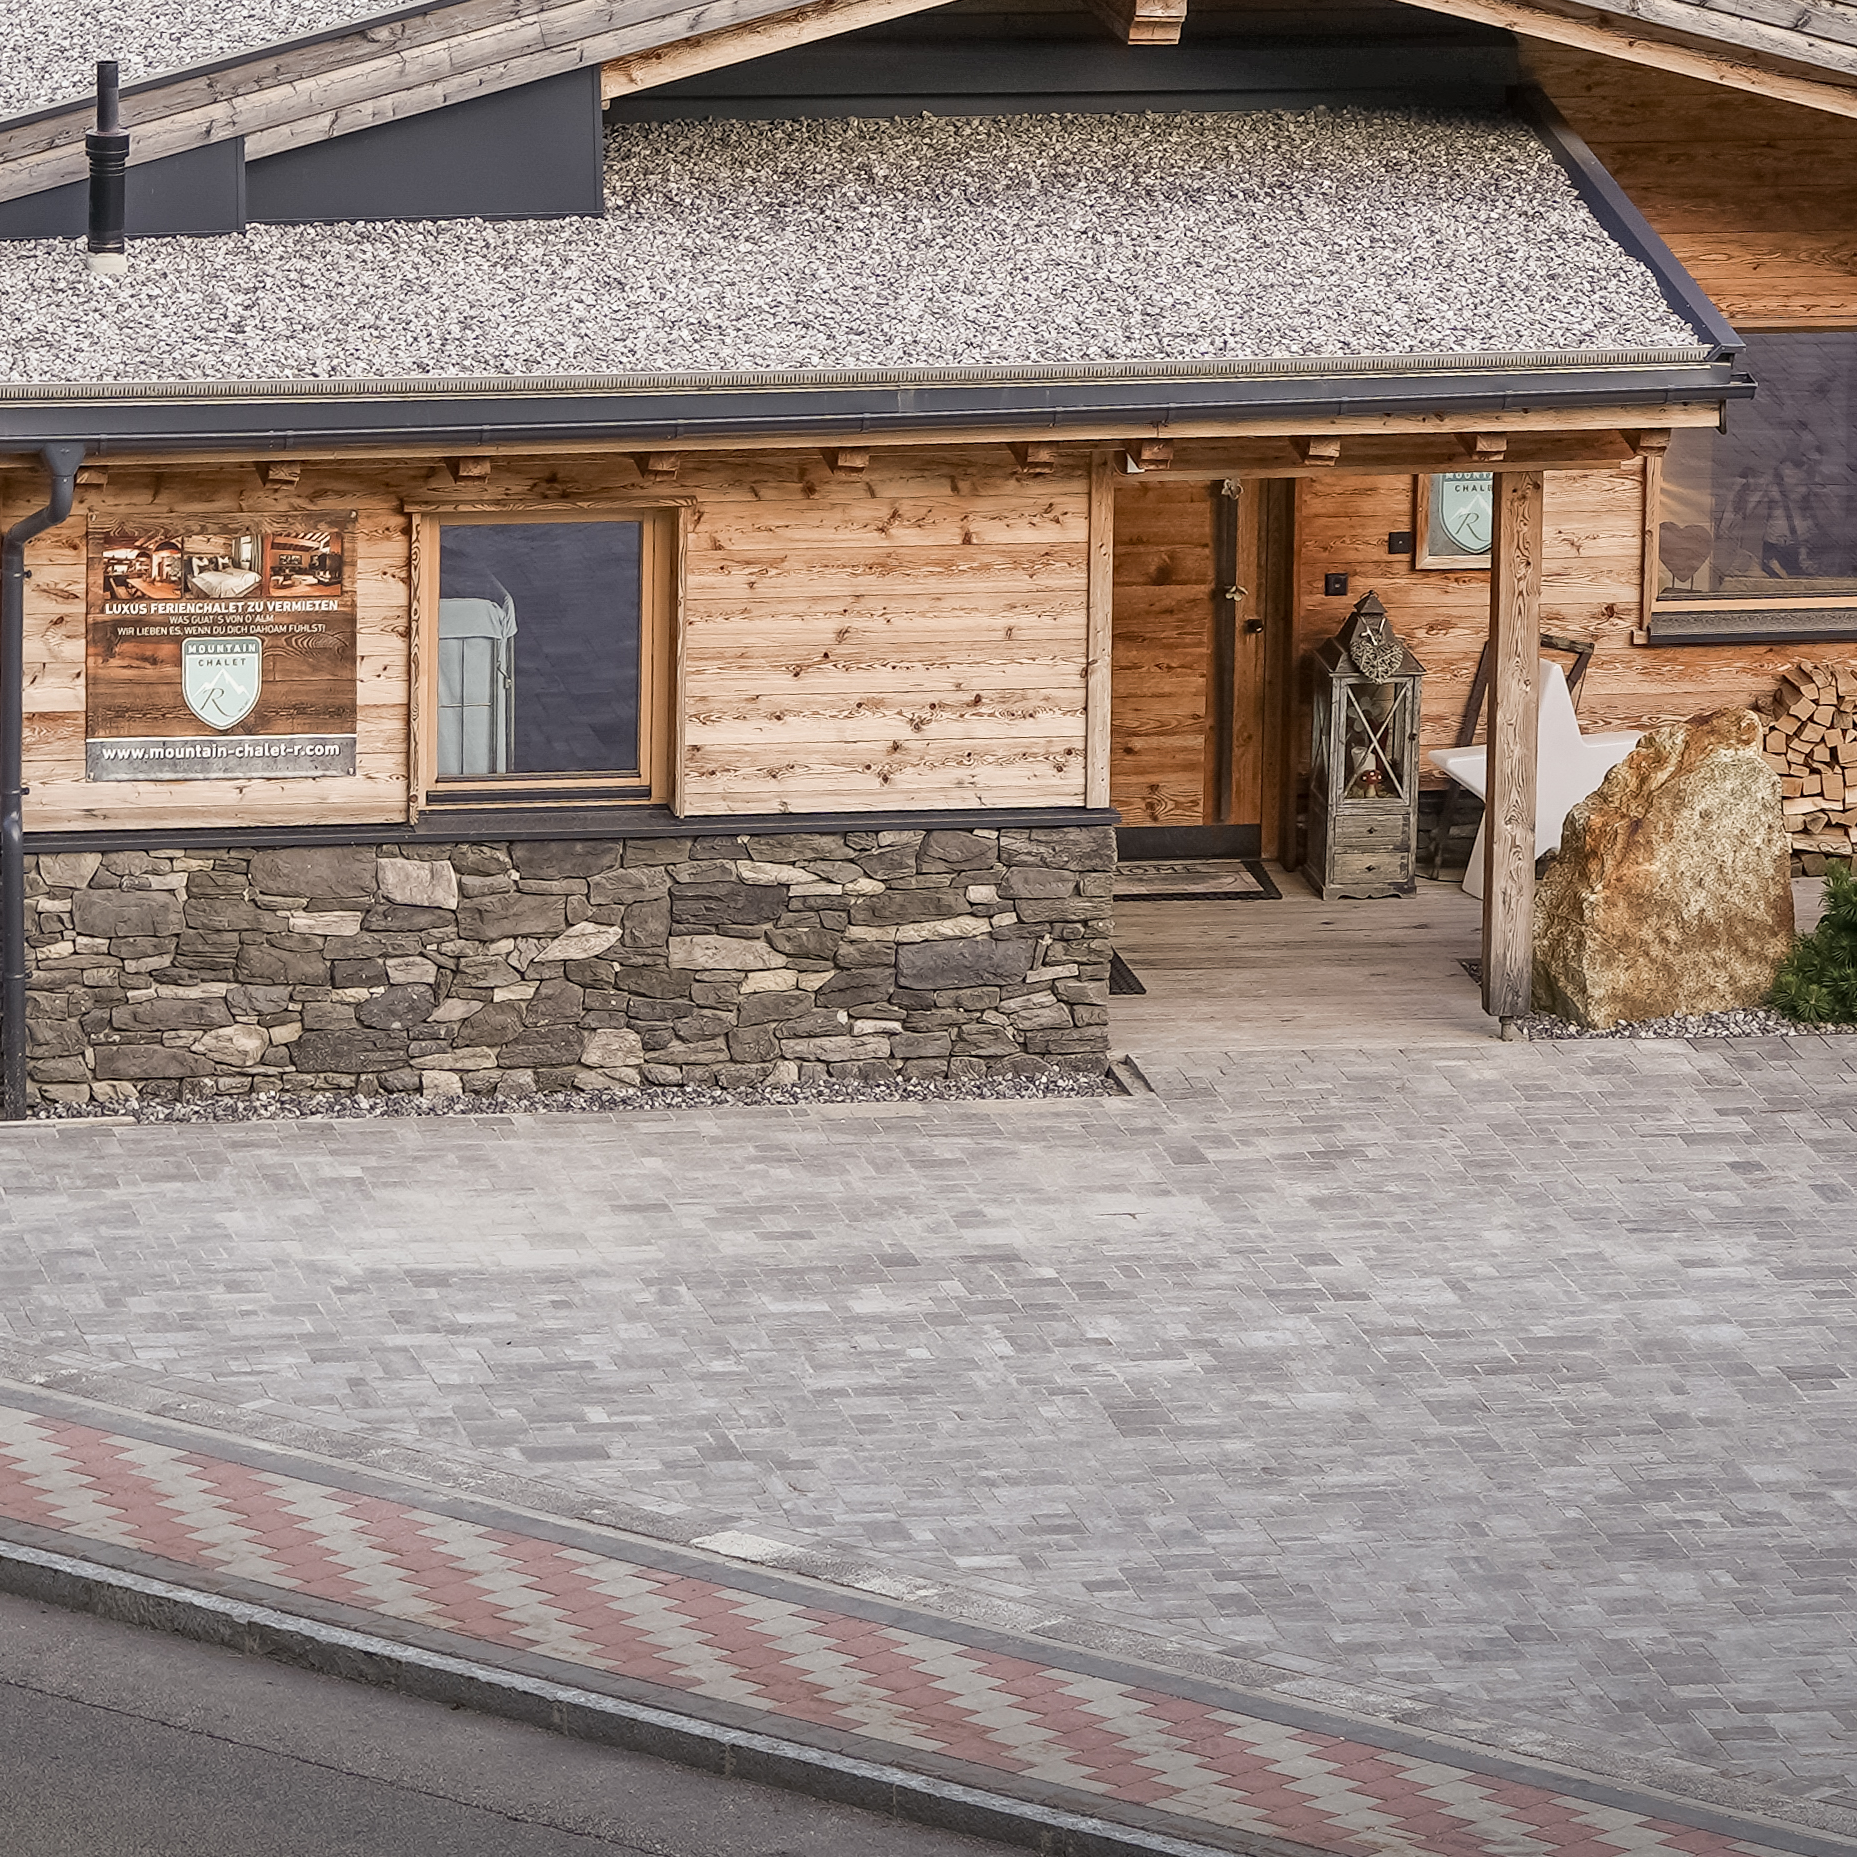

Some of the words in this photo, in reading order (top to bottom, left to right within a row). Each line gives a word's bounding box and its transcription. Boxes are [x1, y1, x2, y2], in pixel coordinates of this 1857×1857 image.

[105, 603, 148, 615] LUXUS
[150, 602, 244, 614] FERIENCHALET
[247, 601, 264, 613] ZU
[266, 600, 339, 612] VERMIETEN
[169, 615, 190, 625] WAS
[225, 614, 244, 624] VON
[117, 627, 135, 636] WIR
[136, 627, 168, 636] LIEBEN
[184, 626, 211, 635] WENN
[213, 626, 226, 635] DU
[227, 625, 248, 634] DICH
[249, 624, 287, 634] DAHOAM
[188, 644, 256, 654] MOUNTAIN
[198, 658, 247, 667] CHALET
[199, 687, 237, 718] R
[102, 743, 341, 760] www.mountain-chalet-r.com
